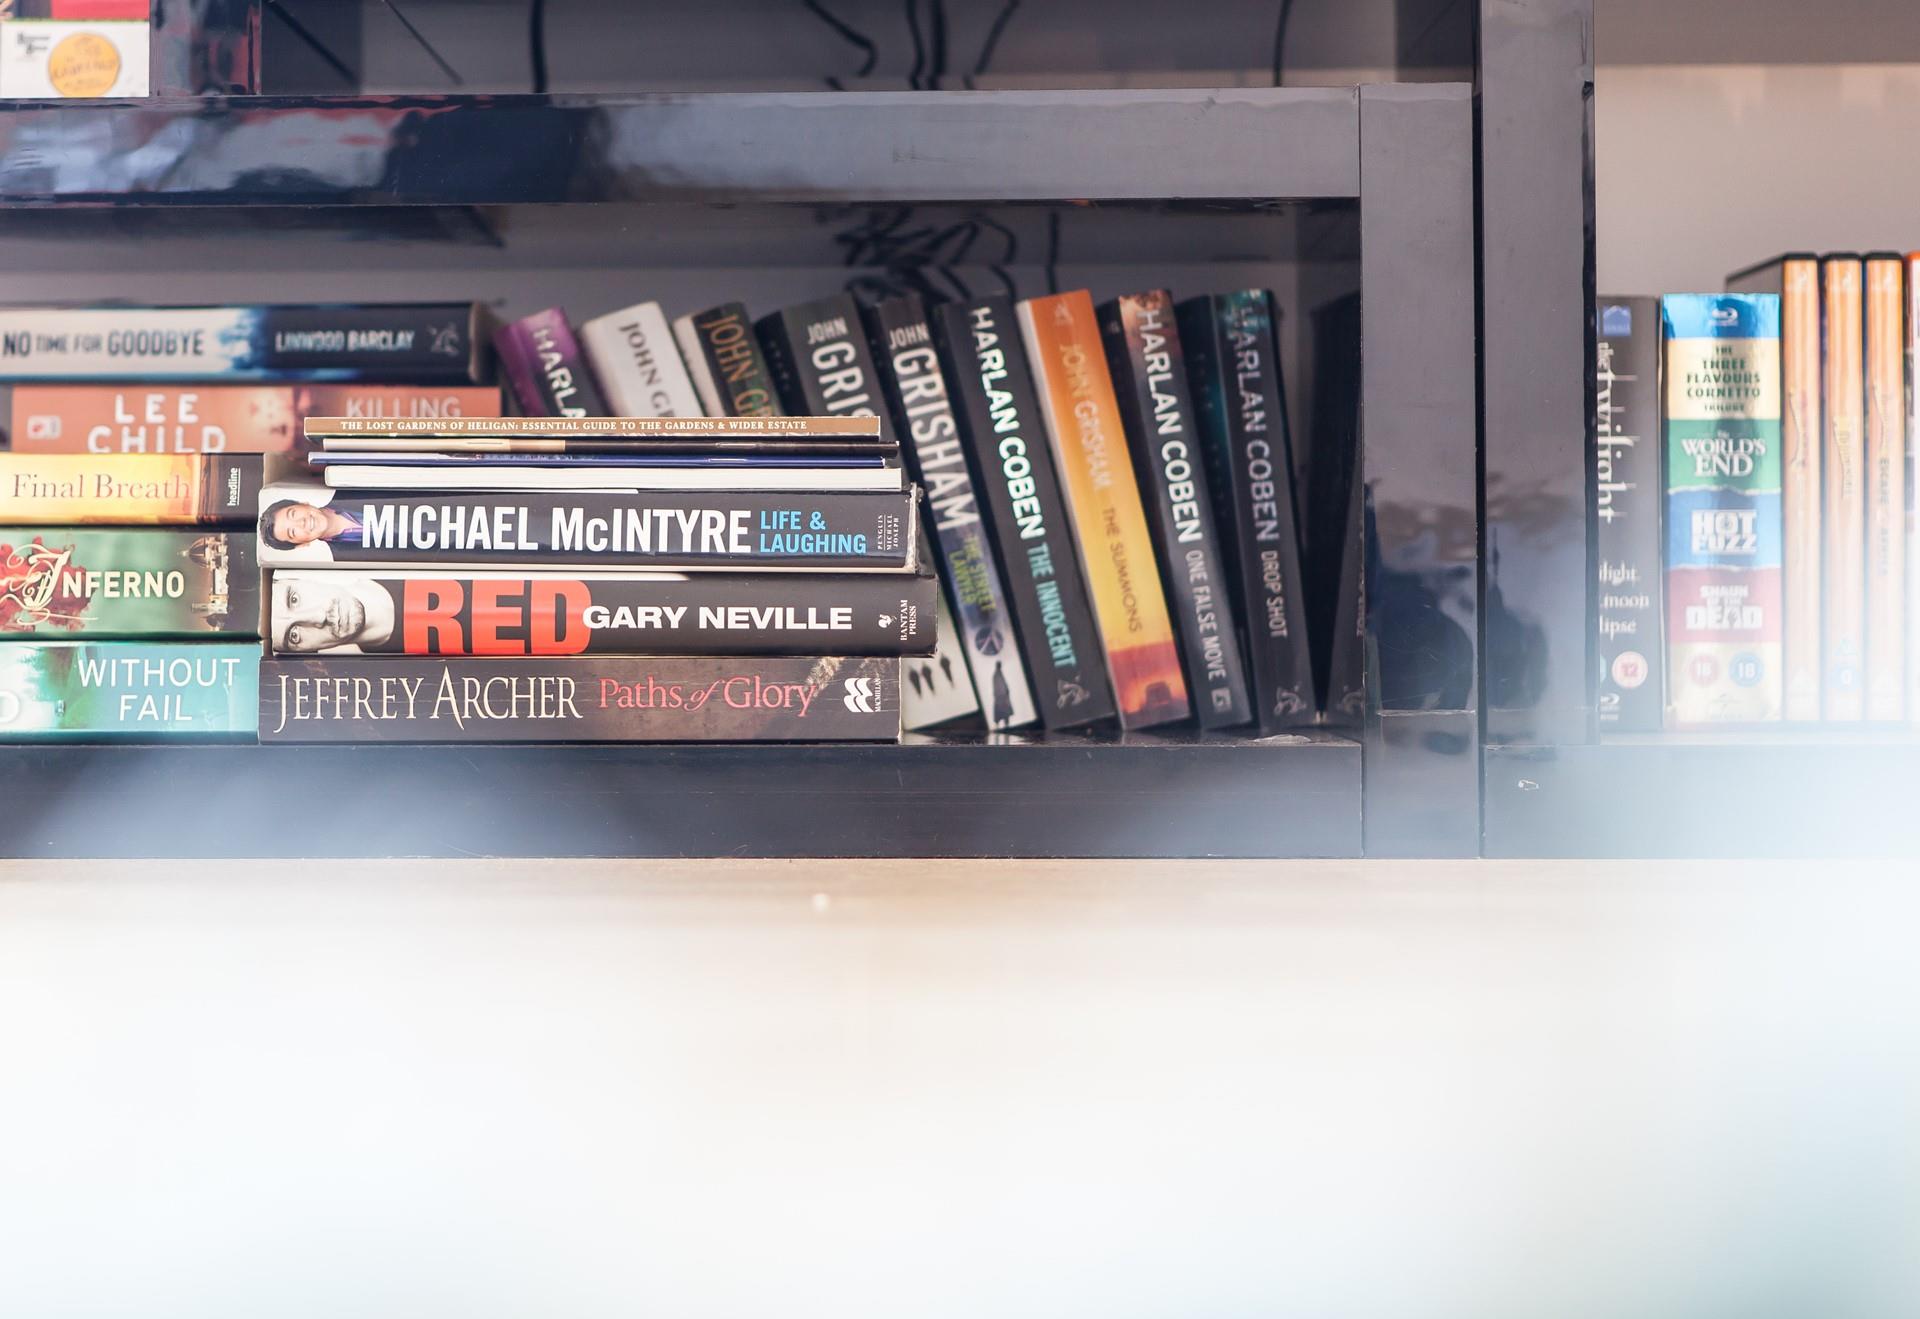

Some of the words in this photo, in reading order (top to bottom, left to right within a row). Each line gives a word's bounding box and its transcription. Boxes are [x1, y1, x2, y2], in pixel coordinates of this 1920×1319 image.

[3, 331, 31, 357] NO
[36, 333, 67, 353] TIME
[73, 333, 102, 352] FOR
[108, 329, 205, 357] GOODBYE
[275, 330, 344, 352] LINWOOD
[347, 330, 415, 351] BARCLAY
[807, 317, 848, 345] JOHN
[889, 322, 930, 350] JOHN
[618, 322, 662, 387] JOHN
[702, 313, 758, 384] JOHN
[1715, 345, 1733, 354] THE
[969, 306, 1021, 433] HARLAN
[1059, 343, 1091, 398] JOHN
[1136, 309, 1182, 435] HARLAN
[1686, 373, 1761, 384] FLAVOURS
[1703, 359, 1746, 370] THREE
[115, 393, 199, 424] LEE
[346, 396, 462, 417] KILLING
[1687, 388, 1761, 399] CORNETTO
[88, 425, 226, 453] CHILD
[341, 421, 363, 430] THE
[366, 421, 394, 430] LOST
[397, 421, 447, 430] GARDENS
[450, 421, 464, 430] OF
[468, 421, 519, 430] HELIGAN:
[523, 421, 579, 430] ESSENTIAL
[583, 421, 617, 430] GUIDE
[621, 421, 636, 430] TO
[640, 421, 661, 430] THE
[665, 421, 714, 430] GARDENS
[718, 421, 725, 430] &
[729, 421, 764, 430] WIDER
[768, 421, 807, 430] ESTATE
[893, 347, 980, 531] GRISHAM
[1074, 400, 1113, 491] GRISHAM
[1681, 438, 1767, 456] WORLD'S
[1694, 454, 1754, 477] END
[13, 473, 84, 498] Final
[95, 473, 190, 498] Breath
[227, 468, 238, 507] headline
[999, 436, 1046, 541] COBEN
[1161, 440, 1203, 543] COBEN
[1247, 440, 1280, 541] COBEN
[362, 504, 538, 551] MICHAEL
[551, 507, 752, 553] McINTYRE
[760, 511, 802, 530] LIFE
[809, 511, 826, 530] &
[1103, 507, 1121, 537] THE
[1691, 509, 1758, 536] HOT
[760, 534, 866, 554] LAUGHING
[1691, 534, 1758, 555] FUZZ
[1027, 543, 1054, 578] THE
[1185, 550, 1209, 583] ONE
[1260, 550, 1282, 594] DROP
[1110, 543, 1142, 633] SUMMONS
[1700, 584, 1749, 599] SHAUN
[403, 579, 592, 655] RED
[582, 605, 688, 630] GARY
[699, 606, 852, 630] NEVILLE
[900, 599, 908, 641] BANTAM
[1036, 580, 1077, 667] INNOCENT
[1192, 585, 1218, 634] FALSE
[1266, 598, 1288, 638] SHOT
[1685, 605, 1763, 630] DEAD
[78, 658, 240, 687] WITHOUT
[1202, 636, 1227, 681] MOVE
[119, 694, 193, 721] FAIL
[273, 674, 424, 733] JEFFREY
[430, 665, 583, 730] ARCHER
[600, 675, 682, 708] Paths
[683, 678, 725, 711] of
[724, 675, 817, 717] Glory
